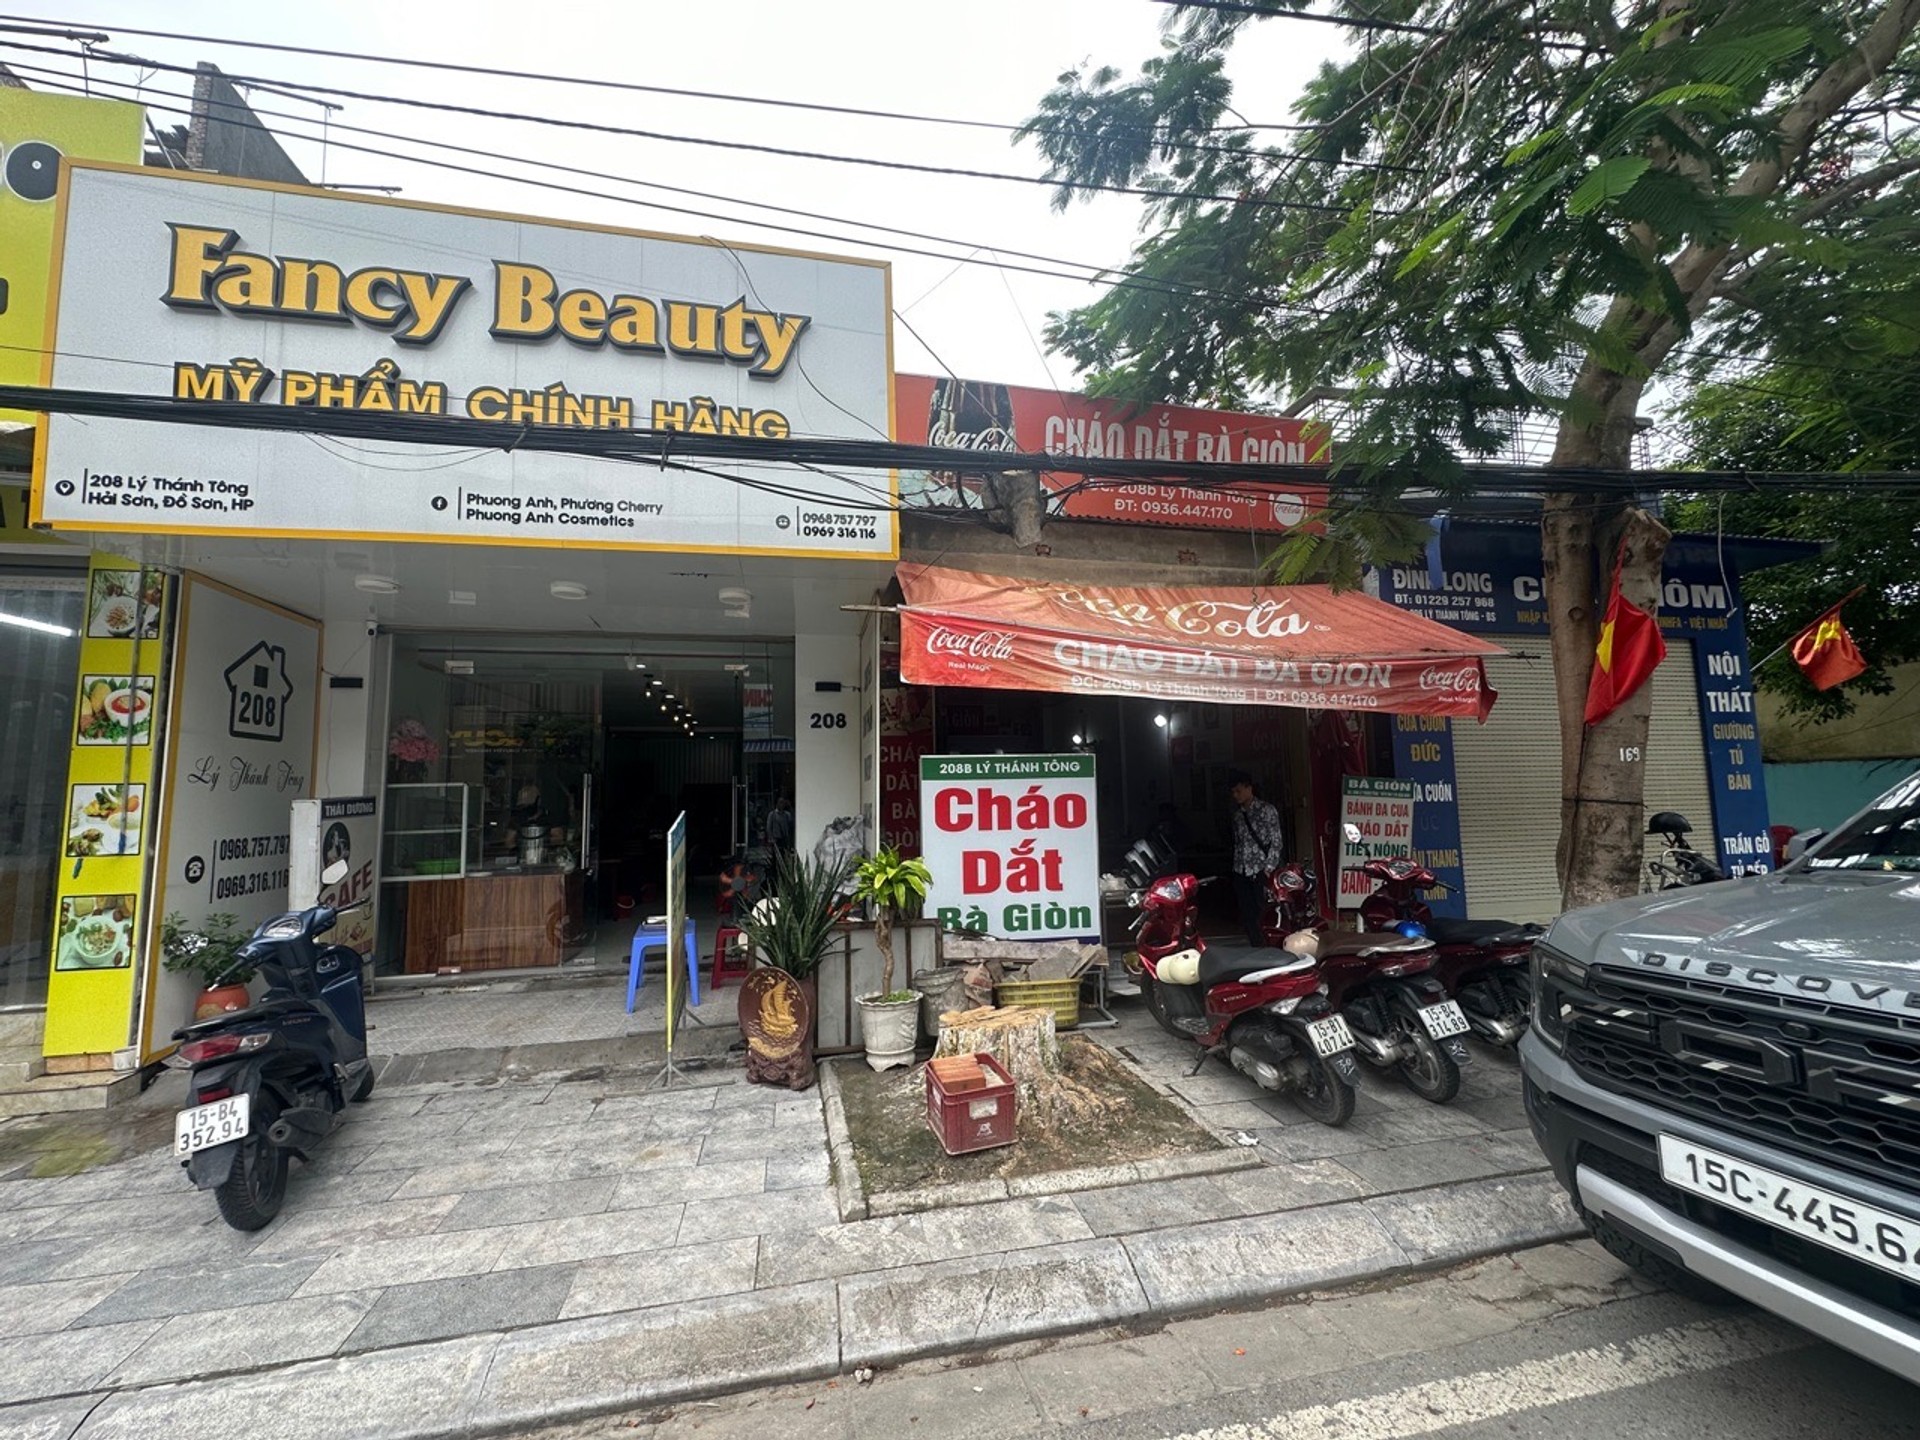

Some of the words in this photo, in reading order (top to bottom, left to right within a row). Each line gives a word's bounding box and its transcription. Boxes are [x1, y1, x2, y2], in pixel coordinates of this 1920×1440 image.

[160, 221, 474, 345] Fancy
[489, 259, 811, 380] Beauty
[174, 357, 275, 403] MỸ
[281, 358, 448, 415] PHẨM
[466, 381, 634, 428] CHÍNH
[652, 396, 790, 438] HÃNG
[1045, 411, 1125, 458] CHÁO
[1197, 425, 1232, 463] BÀ
[90, 475, 123, 488] 208
[128, 476, 148, 492] Lý
[153, 477, 204, 493] Thánh
[209, 480, 249, 497] Tông
[88, 492, 117, 505] Hải
[121, 493, 159, 510] Sơn,
[163, 493, 188, 509] Đồ
[191, 496, 228, 512] Sơn,
[231, 499, 255, 511] HP
[525, 496, 558, 511] Anh,
[617, 500, 664, 516] Cherry
[1114, 499, 1137, 512] ĐT:
[1141, 501, 1233, 520] 0936.447.170
[525, 511, 554, 524] Anh
[558, 513, 635, 528] Cosmetics
[1443, 571, 1493, 593] LONG
[1452, 595, 1472, 607] 257
[926, 625, 1017, 661] Coca-Cola
[1707, 650, 1741, 680] NỘI
[238, 691, 276, 728] 208
[1706, 685, 1752, 713] THẤT
[811, 712, 847, 729] 208
[1410, 739, 1441, 762] ĐỨC
[1619, 746, 1641, 762] 169
[1728, 743, 1745, 765] TỦ
[938, 762, 972, 775] 208B
[976, 759, 991, 774] LÝ
[994, 759, 1040, 774] THÁNH
[1042, 758, 1081, 772] TÔNG
[1727, 770, 1752, 791] BÀN
[892, 798, 917, 820] BÀ
[933, 785, 1088, 833] Cháo
[219, 834, 290, 861] 0968.757.797
[886, 826, 921, 848] GIÒ
[961, 838, 1064, 895] Dắt
[1426, 848, 1460, 868] THANG
[216, 868, 289, 900] 0969.316.116
[936, 904, 988, 933] Bà
[1003, 901, 1092, 933] Giòn
[1425, 1004, 1457, 1023] 15-B4
[1312, 1017, 1344, 1039] 15-B1
[189, 1100, 239, 1130] 15-B4
[180, 1117, 245, 1151] 352.94
[1685, 1152, 1920, 1267] 15C-445.6
